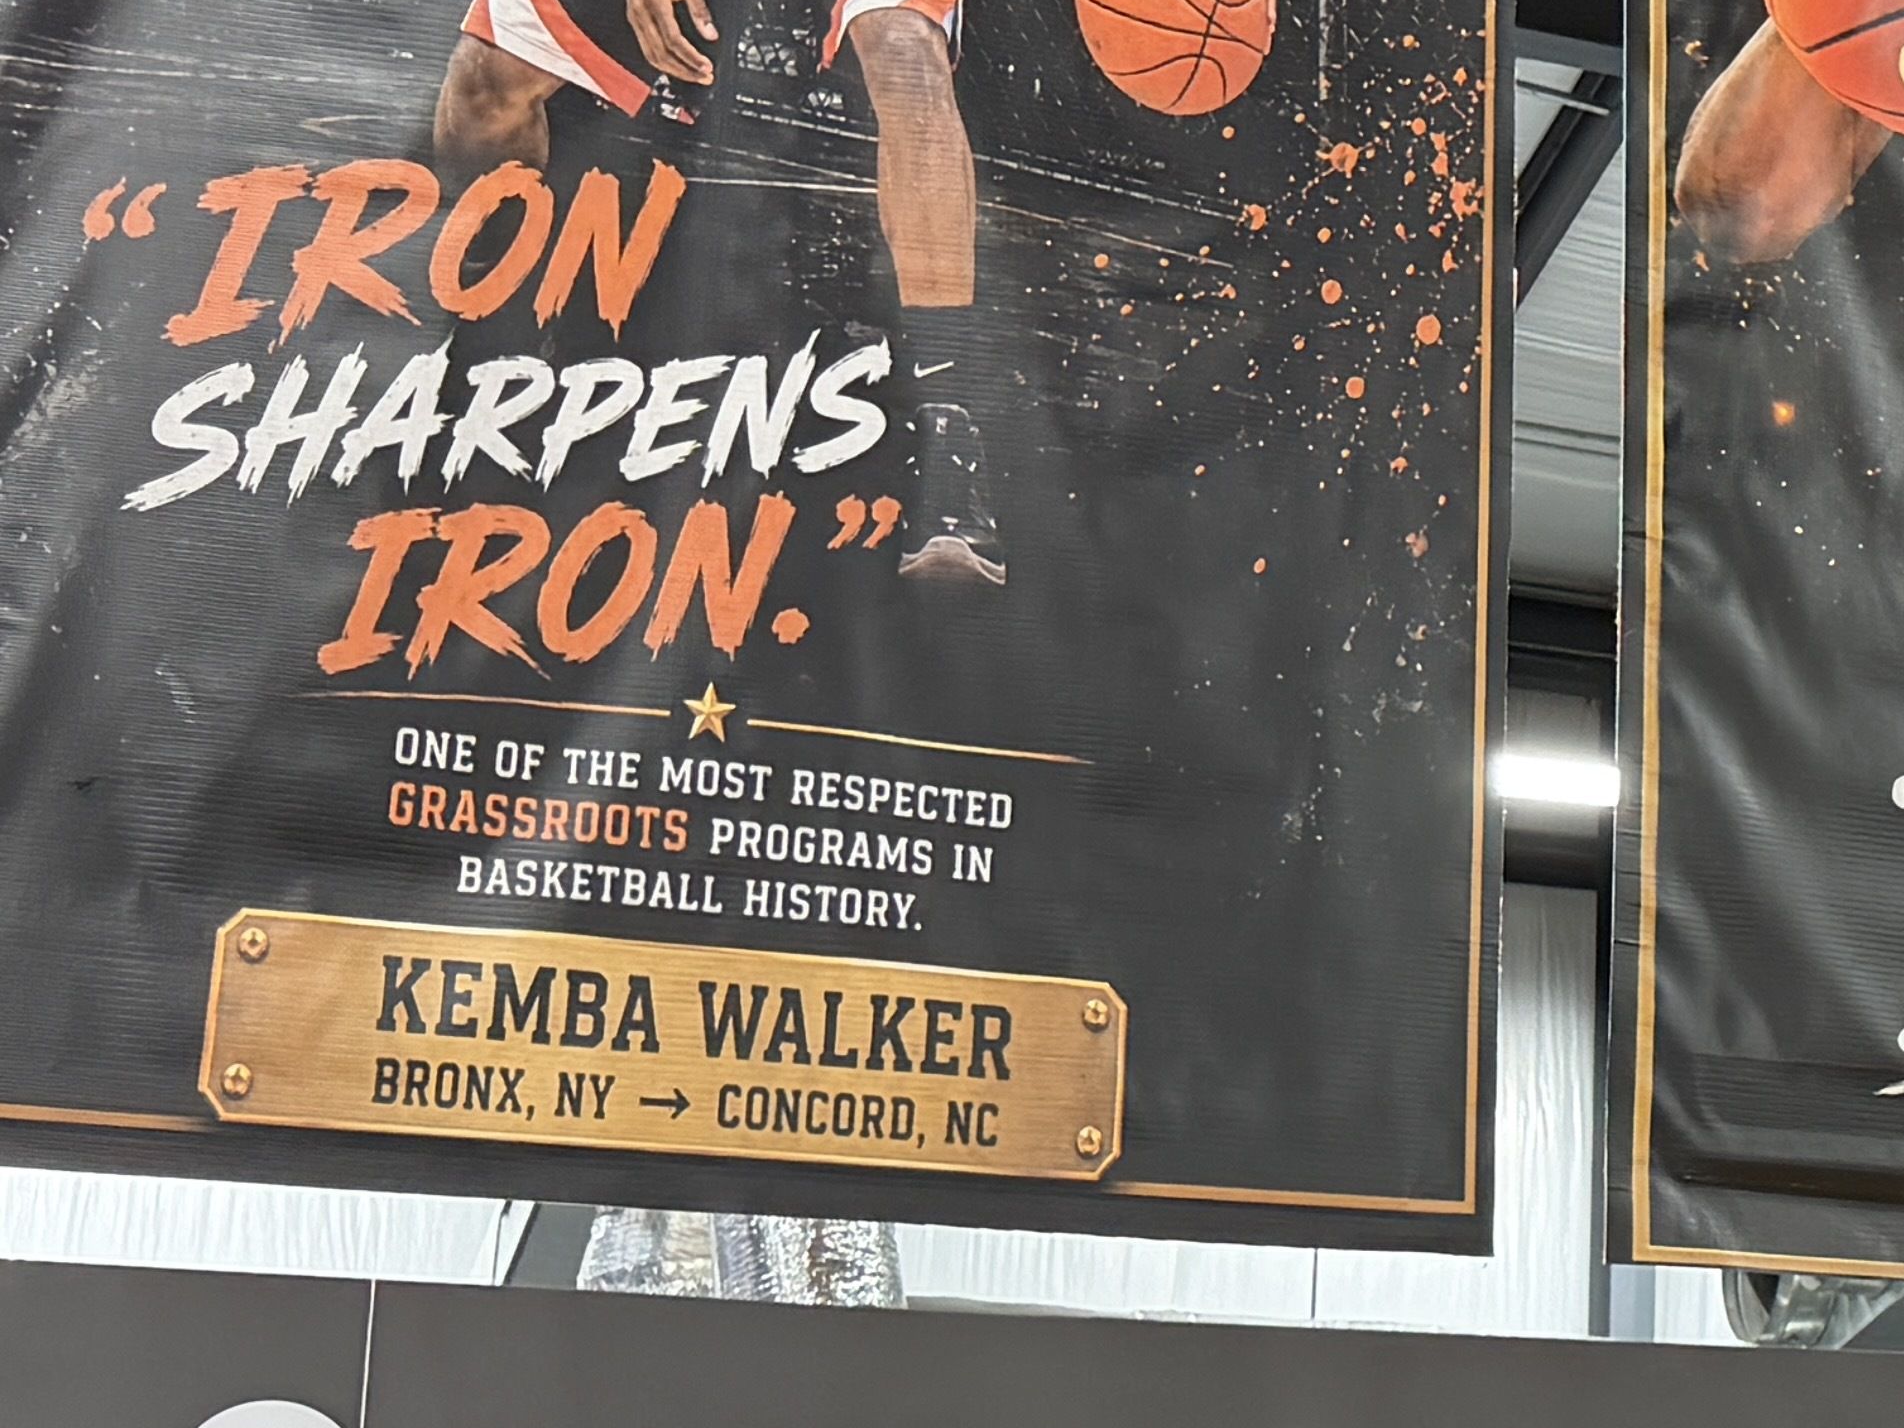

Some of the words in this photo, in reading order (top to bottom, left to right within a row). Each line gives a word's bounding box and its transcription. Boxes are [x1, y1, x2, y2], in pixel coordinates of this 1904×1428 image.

[120, 327, 891, 511] SHARPENS
[394, 726, 476, 774] ONE
[495, 734, 545, 782] OF
[564, 745, 642, 791] THE
[661, 755, 774, 804] MOST
[792, 770, 1013, 832] RESPECTED
[387, 783, 690, 852] GRASSROOTS
[709, 817, 934, 879] PROGRAMS
[952, 842, 993, 884] IN
[456, 856, 723, 916] BASKETBALL
[743, 881, 924, 932] HISTORY.
[375, 954, 663, 1056] KEMBA
[700, 980, 1015, 1082] WALKER
[372, 1057, 537, 1122] BRONX,
[553, 1073, 617, 1121] NY
[715, 1083, 929, 1150] CONCORD,
[943, 1100, 1001, 1149] NC
